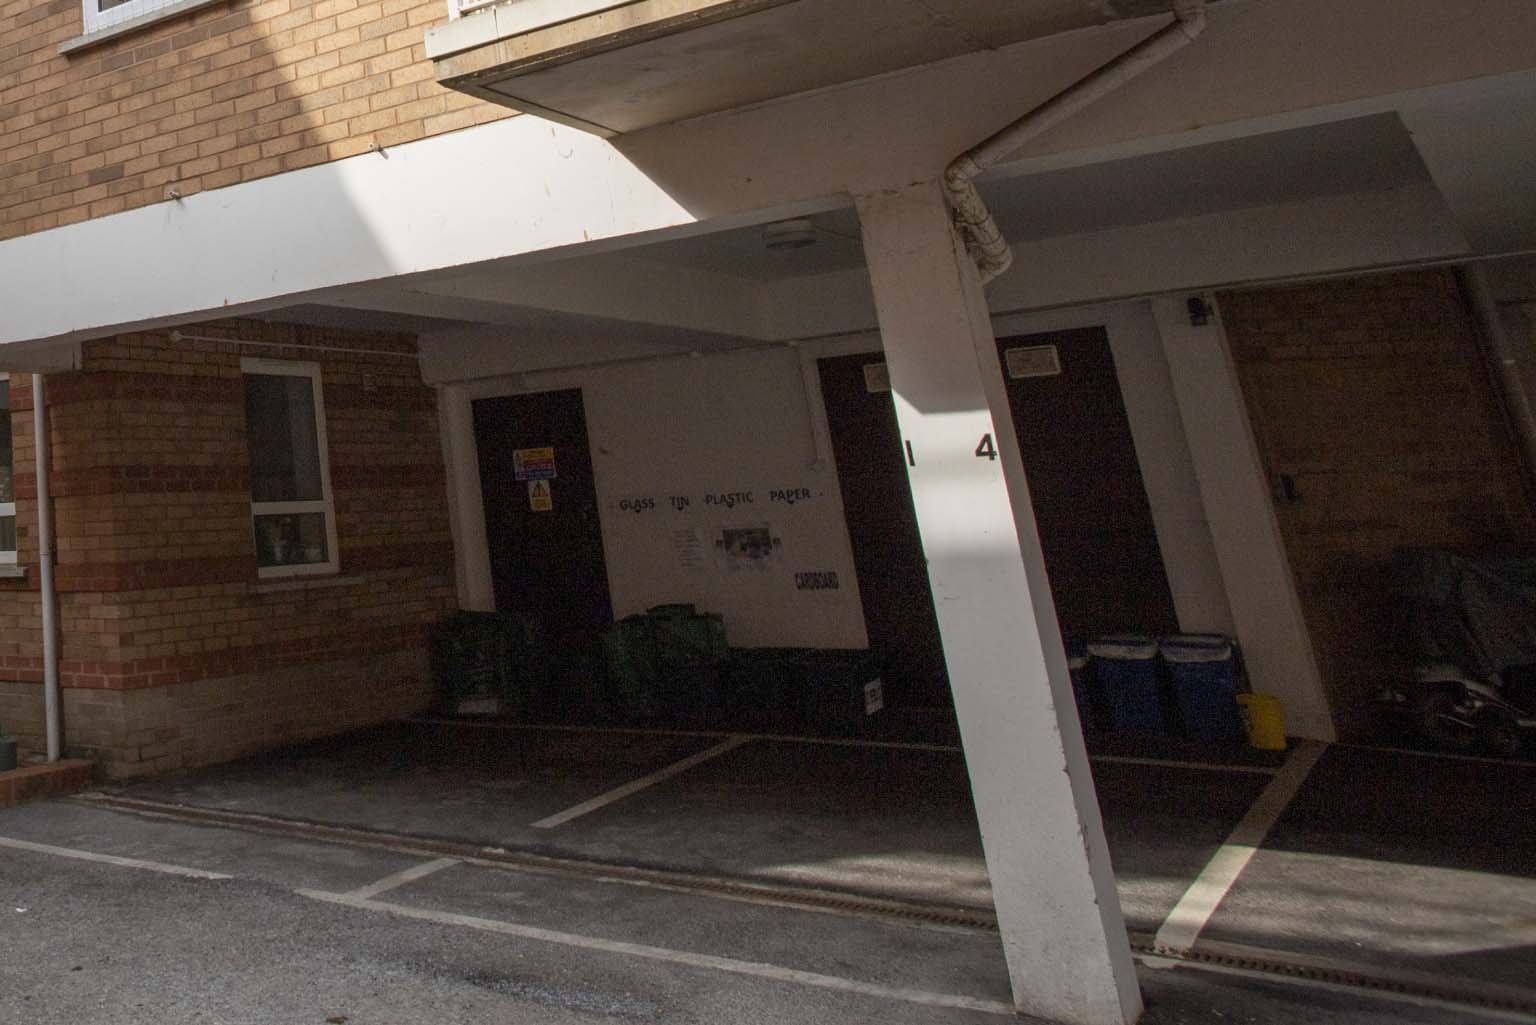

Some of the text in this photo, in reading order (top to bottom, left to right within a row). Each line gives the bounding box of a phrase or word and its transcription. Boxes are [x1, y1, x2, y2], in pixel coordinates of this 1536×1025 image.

[975, 433, 998, 461] 4
[619, 488, 811, 512] GLASS TIN PLASTIC PAPER
